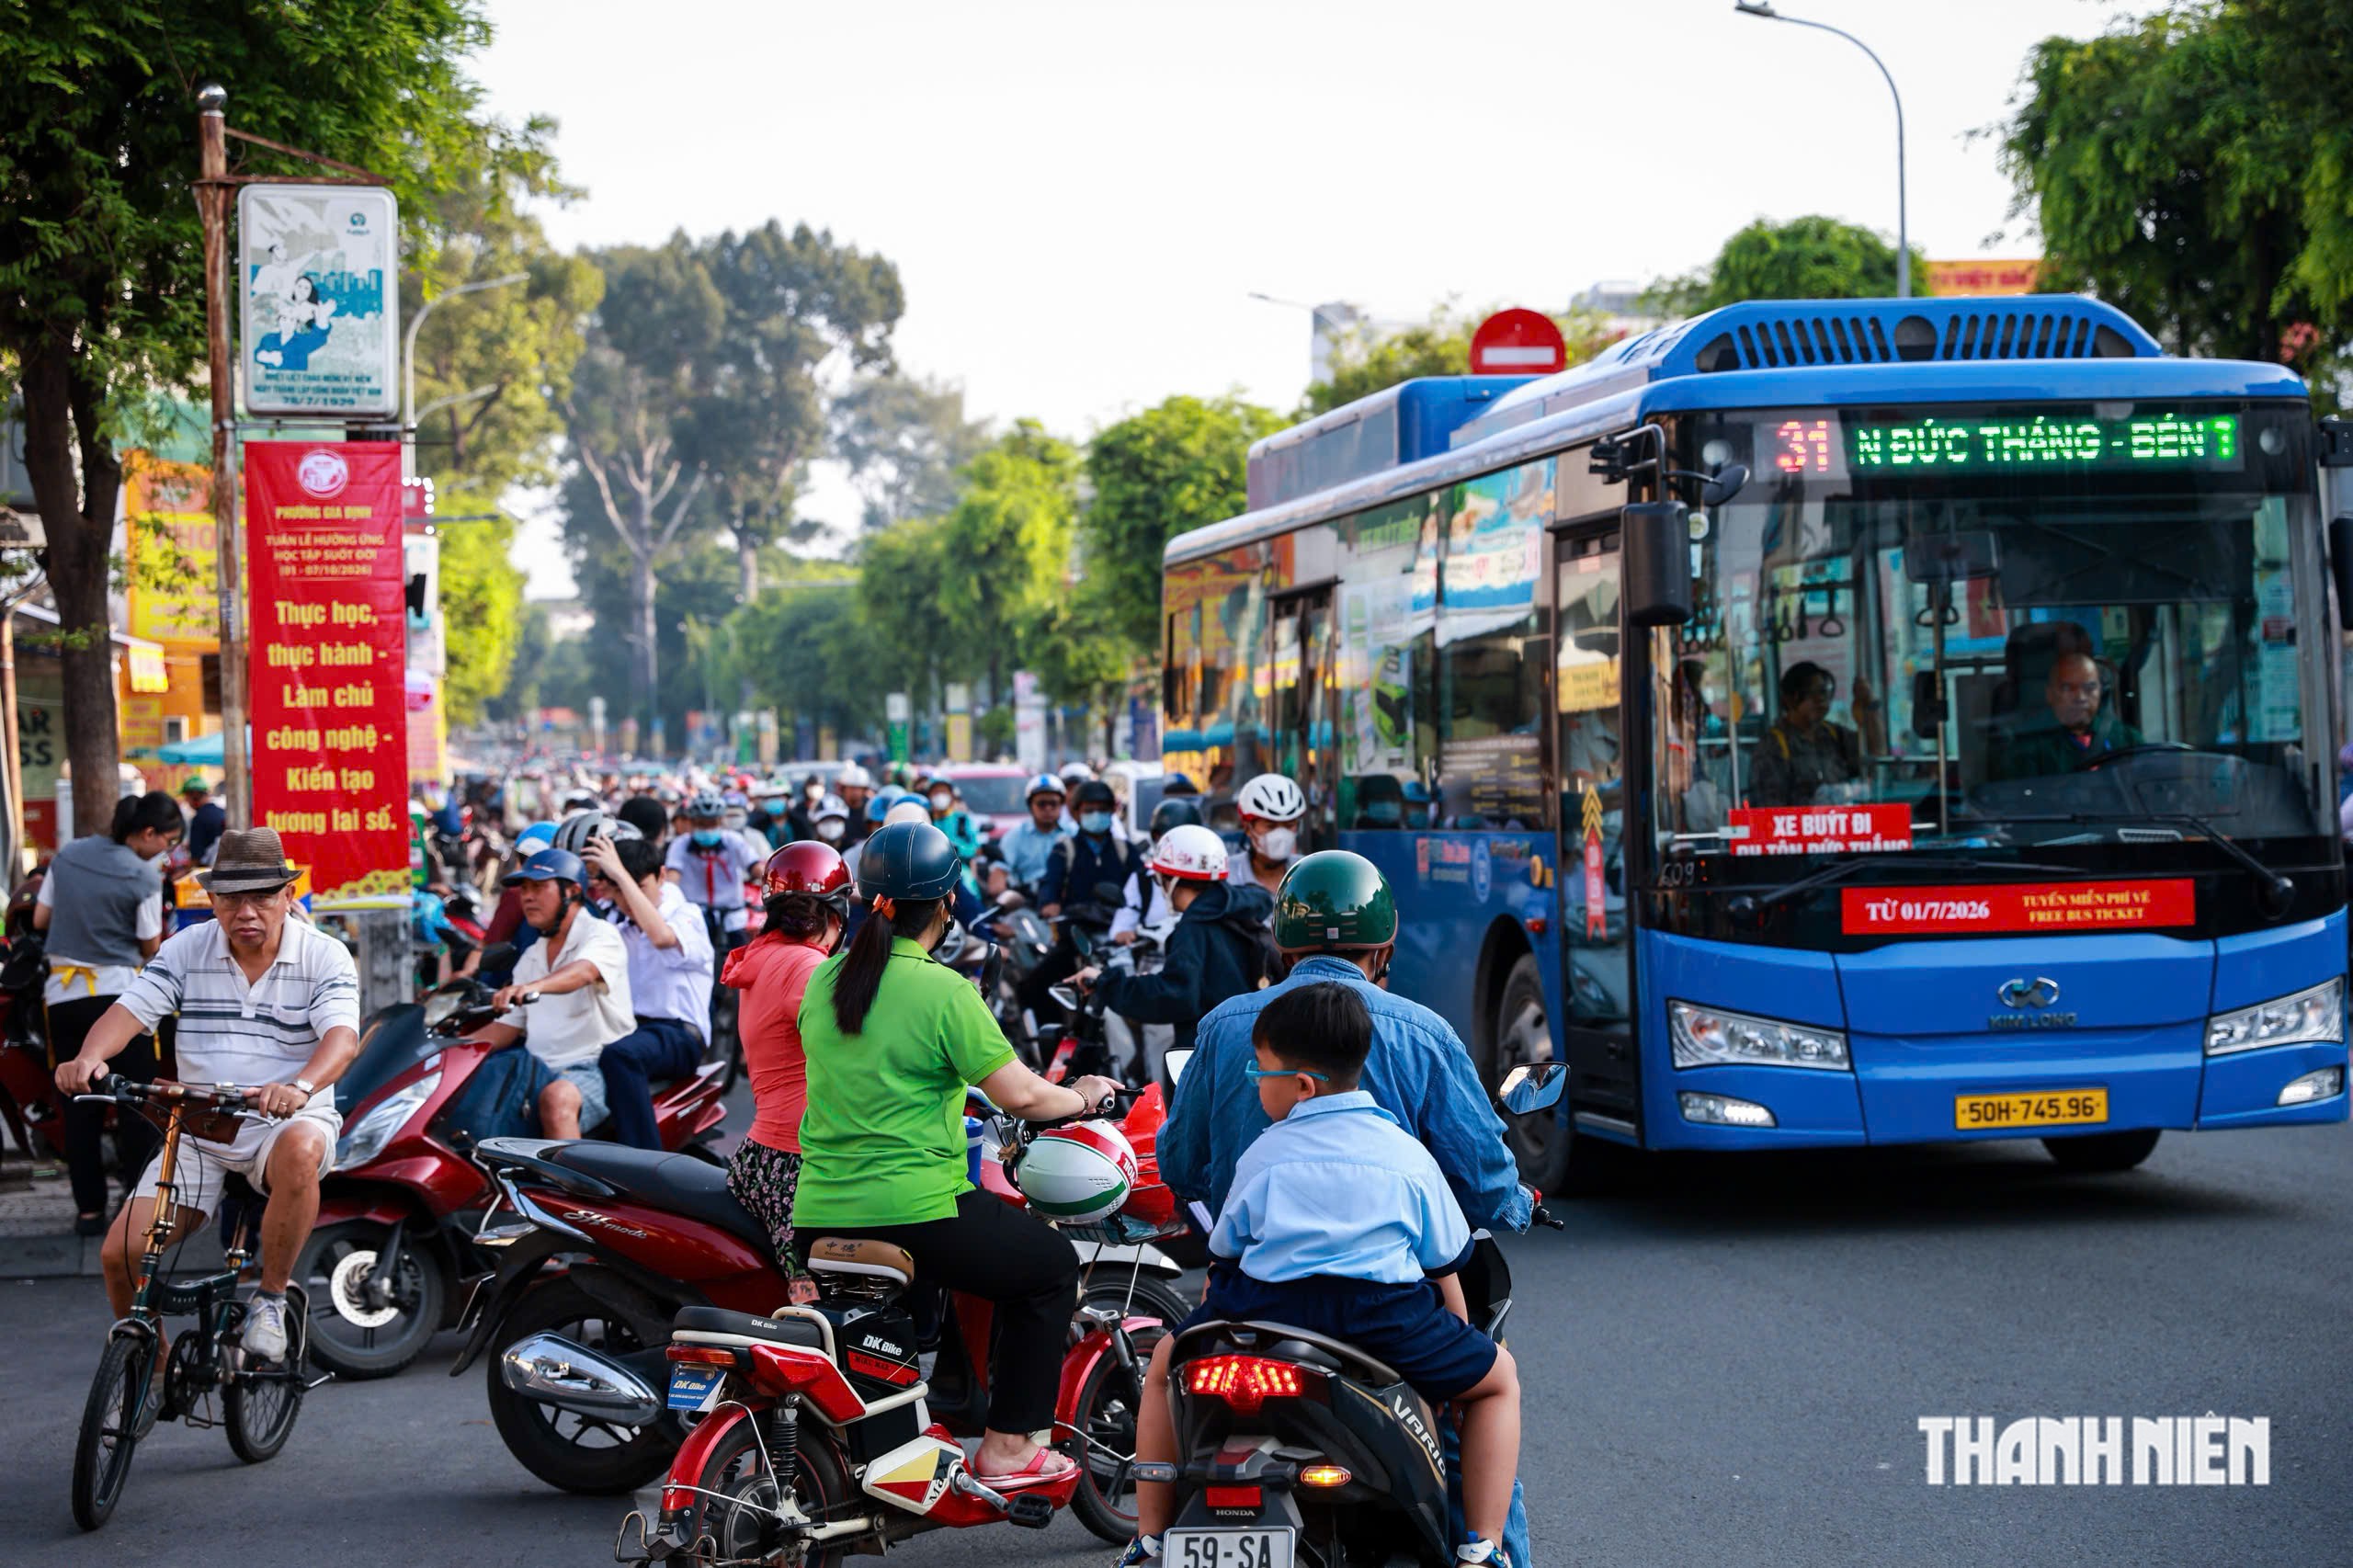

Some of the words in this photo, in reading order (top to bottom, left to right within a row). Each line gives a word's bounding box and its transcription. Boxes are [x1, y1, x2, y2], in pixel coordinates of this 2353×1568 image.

[1778, 420, 1827, 472] 31
[275, 600, 326, 630] Thực
[332, 600, 378, 629] học,
[267, 643, 314, 671] thực
[320, 642, 372, 665] hành
[283, 684, 328, 708] Làm
[334, 680, 374, 707] chủ
[267, 725, 320, 752] công
[325, 724, 378, 753] nghệ
[286, 764, 335, 791] Kiến
[340, 768, 374, 794] tạo
[266, 810, 326, 835] tương
[332, 808, 360, 831] lai
[365, 803, 397, 831] số.
[1773, 815, 1798, 837] XE
[1801, 810, 1847, 836] BUÝT
[1852, 812, 1871, 835] ĐI
[1866, 897, 1897, 921] TỪ
[1900, 900, 1990, 921] 01/7/2026
[2029, 909, 2064, 923] FREE
[2066, 909, 2094, 922] BUS
[2095, 906, 2144, 921] TICKET
[604, 1223, 647, 1239] mode
[751, 1319, 764, 1328] DK
[763, 1322, 779, 1330] Bike
[863, 1334, 883, 1350] DK
[881, 1341, 903, 1357] Bike
[673, 1380, 691, 1390] DK
[688, 1382, 707, 1391] Bike
[1394, 1394, 1446, 1476] VARIO
[1184, 1535, 1272, 1568] 59-SA
